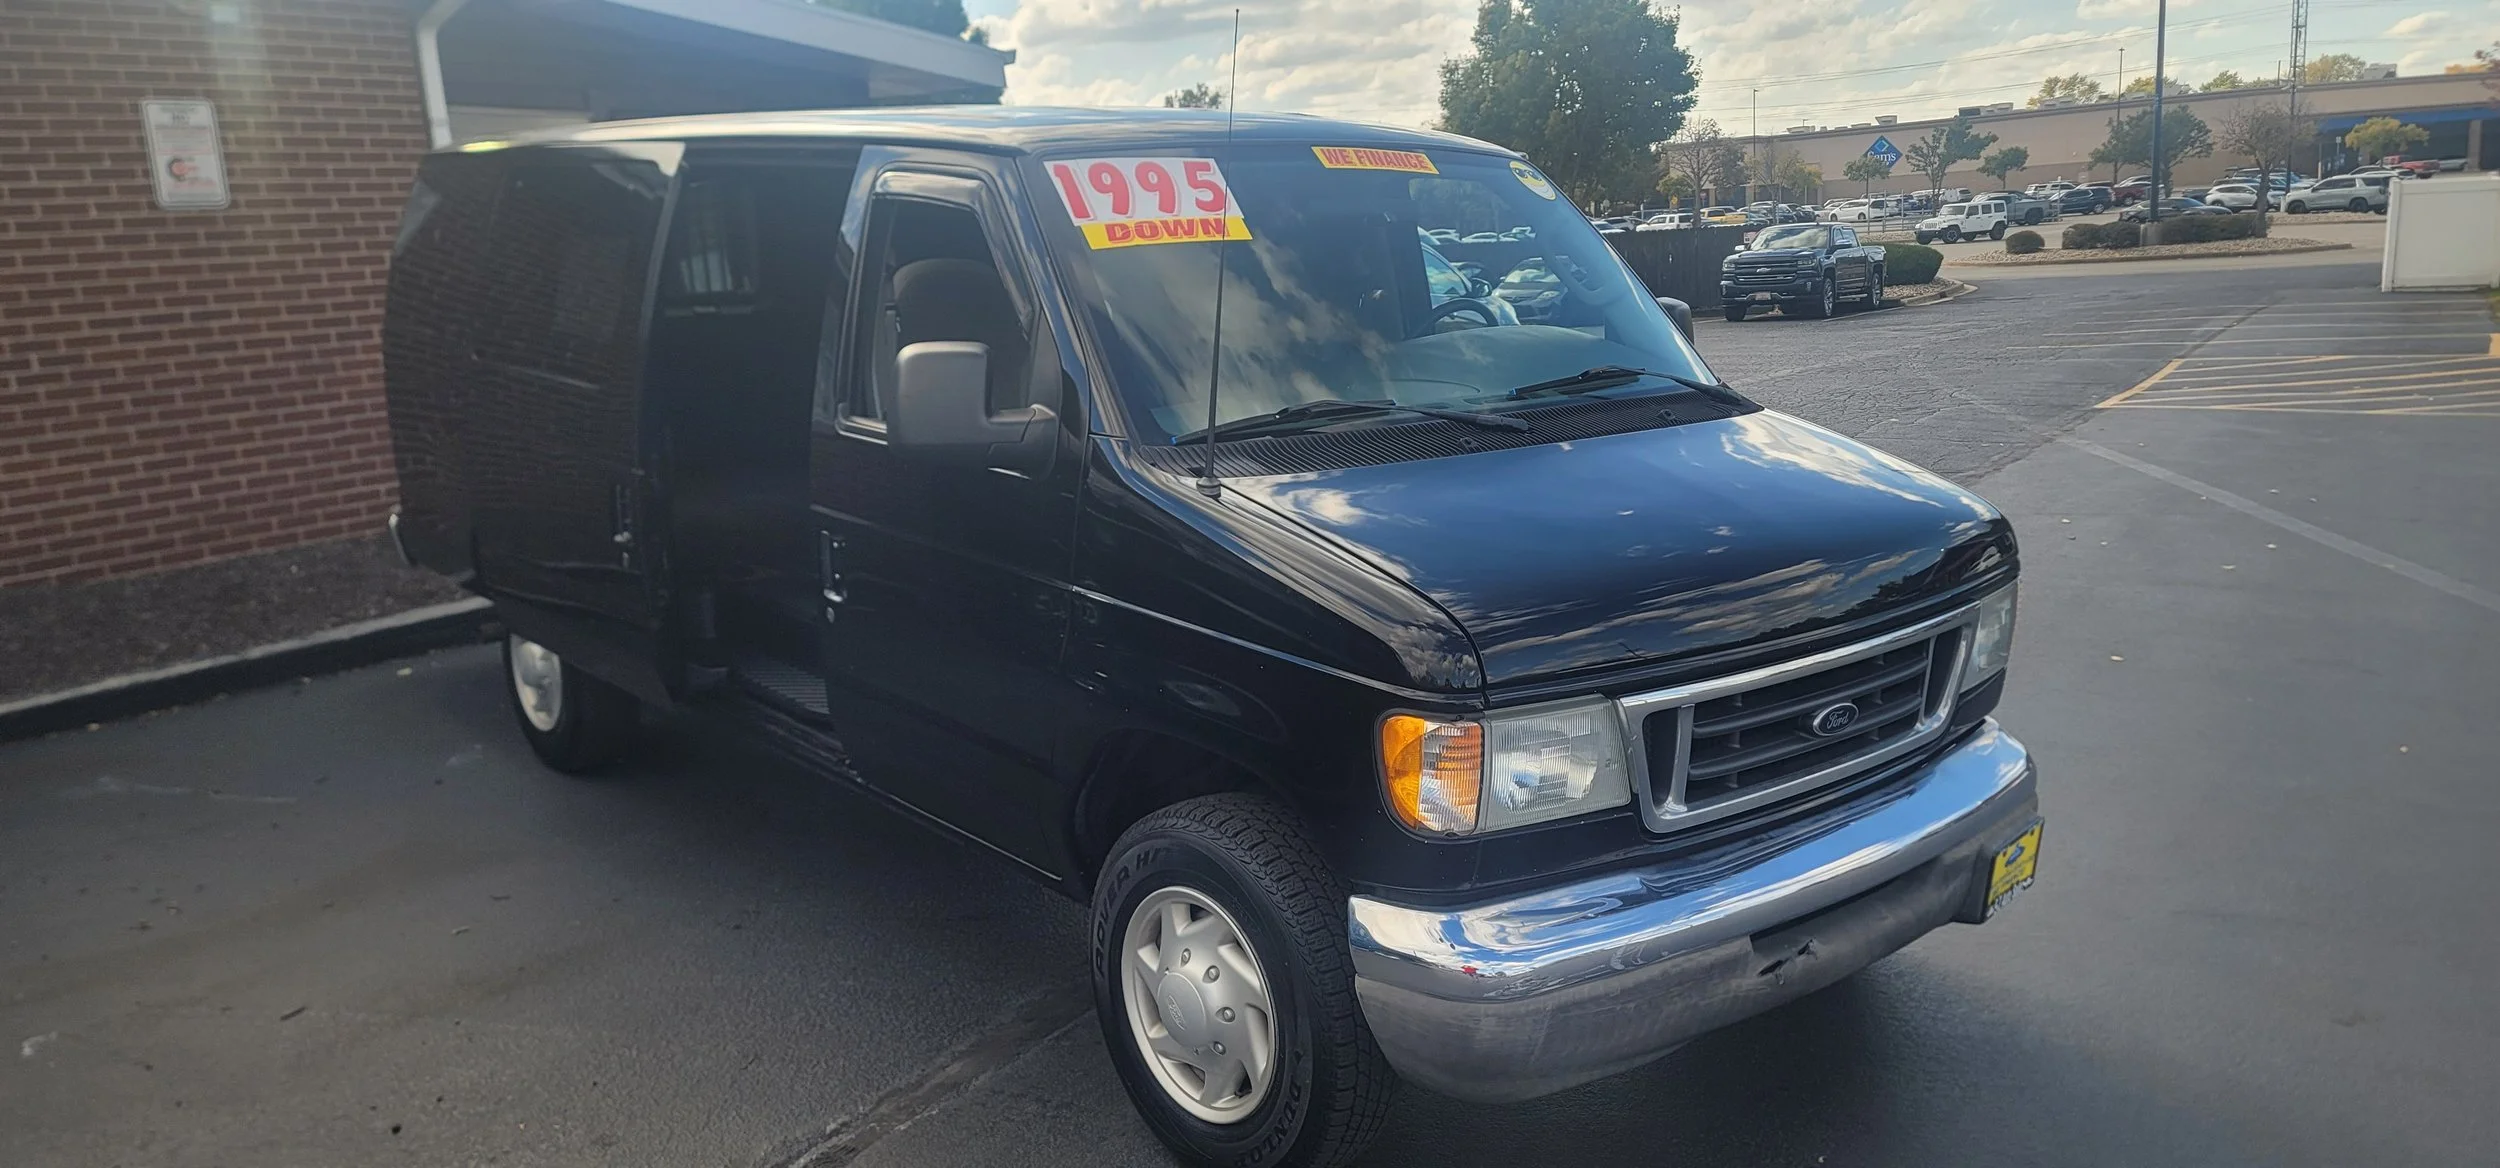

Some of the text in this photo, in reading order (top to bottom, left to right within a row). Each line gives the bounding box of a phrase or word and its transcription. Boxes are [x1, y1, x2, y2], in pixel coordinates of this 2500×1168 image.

[1319, 148, 1433, 171] WE FINANCE
[1053, 160, 1229, 220] 1995
[1105, 217, 1230, 243] DOWN
[1826, 710, 1849, 729] Ford
